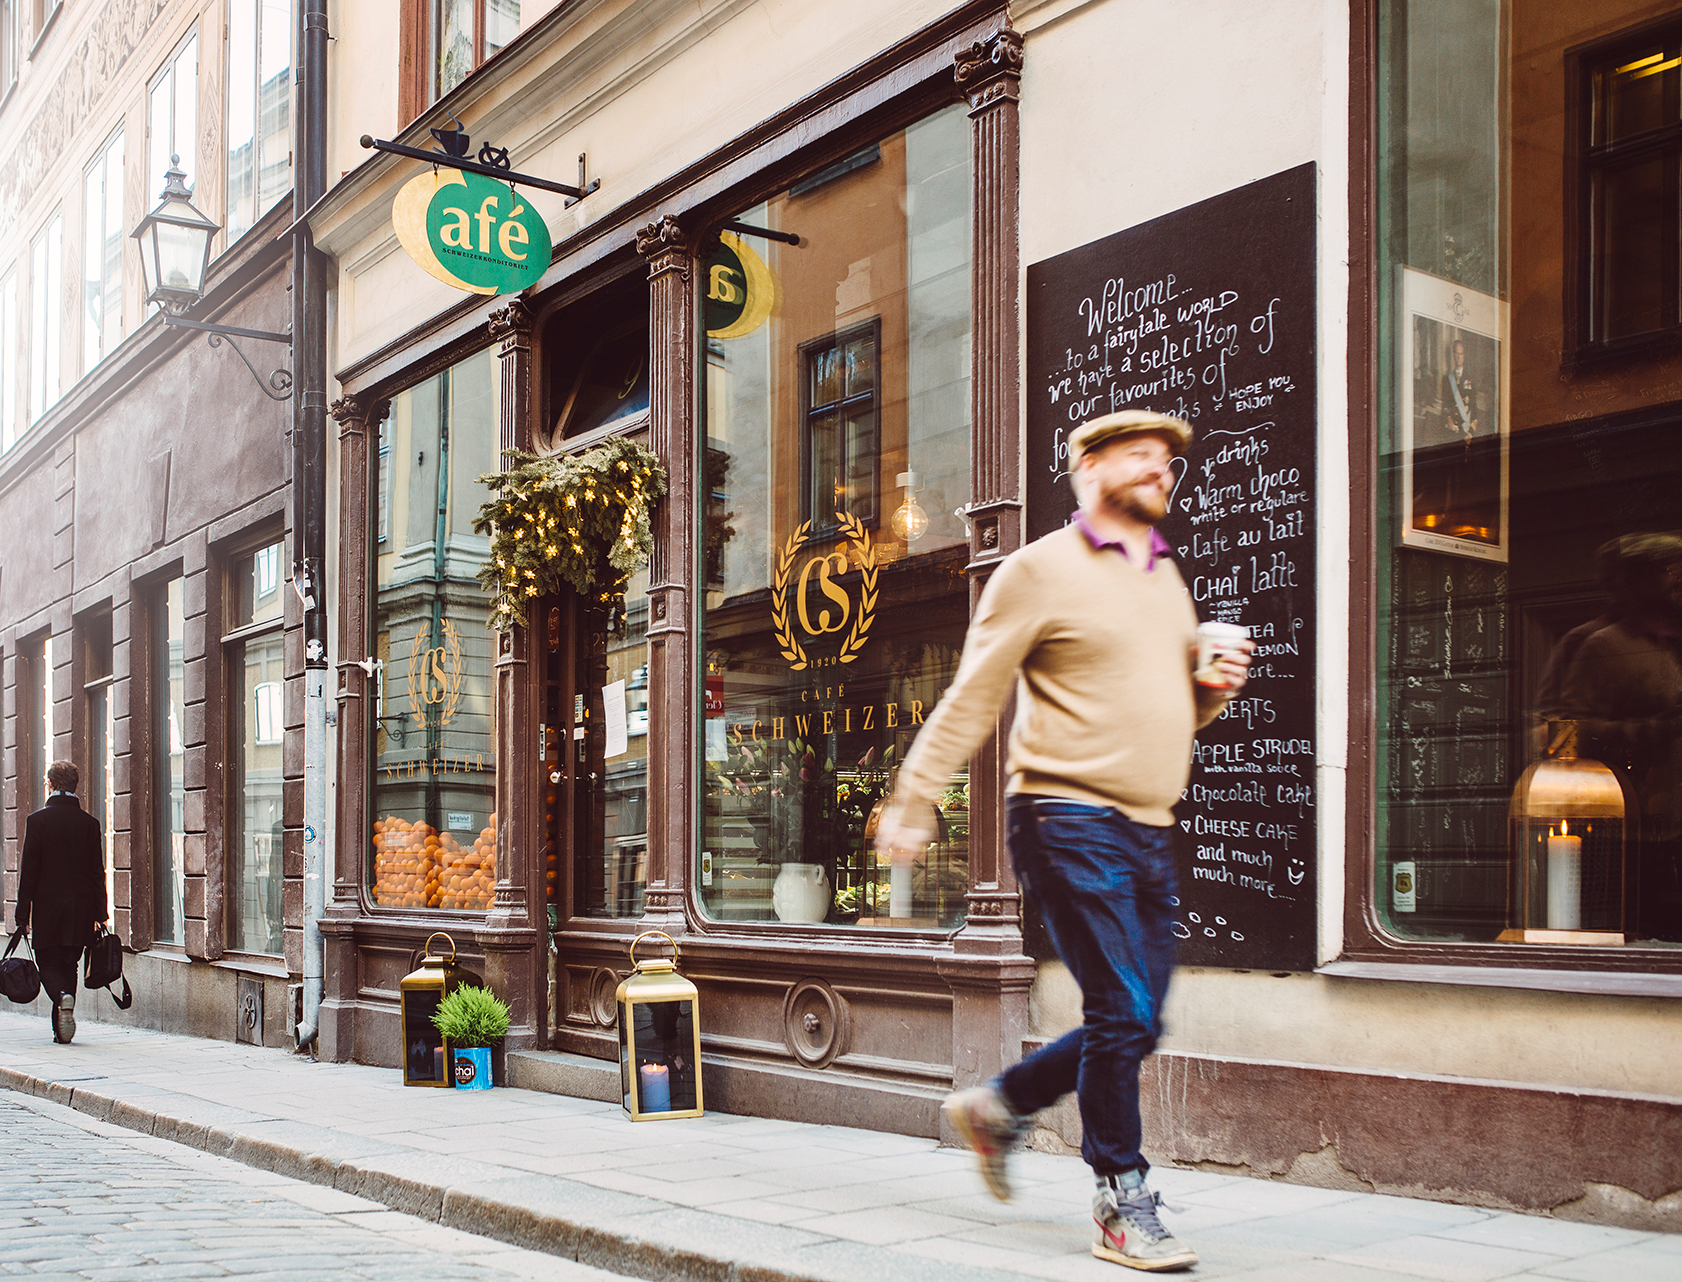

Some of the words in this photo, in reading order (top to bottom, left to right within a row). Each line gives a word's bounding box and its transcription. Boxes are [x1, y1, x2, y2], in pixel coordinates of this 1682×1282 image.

[1078, 364, 1115, 396] have
[1121, 356, 1132, 372] a
[1140, 319, 1239, 373] selection
[1250, 298, 1281, 354] of
[1087, 344, 1100, 361] a
[1104, 308, 1171, 370] fairytale
[1069, 394, 1103, 420] our
[1109, 365, 1196, 414] favourites
[1202, 347, 1230, 402] of
[1229, 383, 1262, 399] HOPE
[1269, 376, 1290, 390] YOU
[1236, 394, 1274, 412] ENJOY
[1216, 436, 1269, 466] drinks
[1194, 473, 1244, 510] Warm
[1251, 464, 1300, 500] choco
[1190, 506, 1228, 525] white
[1231, 502, 1247, 514] or
[1237, 530, 1262, 546] au
[1268, 510, 1304, 542] lait
[1250, 551, 1298, 593] latte
[810, 656, 837, 669] 1920
[801, 683, 846, 702] CAFÉ
[733, 699, 926, 746] SCHWEIZER
[1190, 739, 1245, 764] APPLE
[387, 753, 484, 781] SCHWEIZER
[1204, 764, 1227, 773] with
[1228, 762, 1263, 773] vanilla
[1192, 780, 1271, 810] Chocolate
[1194, 814, 1251, 838] CHEESE
[1196, 842, 1227, 862] and
[1231, 850, 1273, 874] much
[1193, 865, 1236, 885] much
